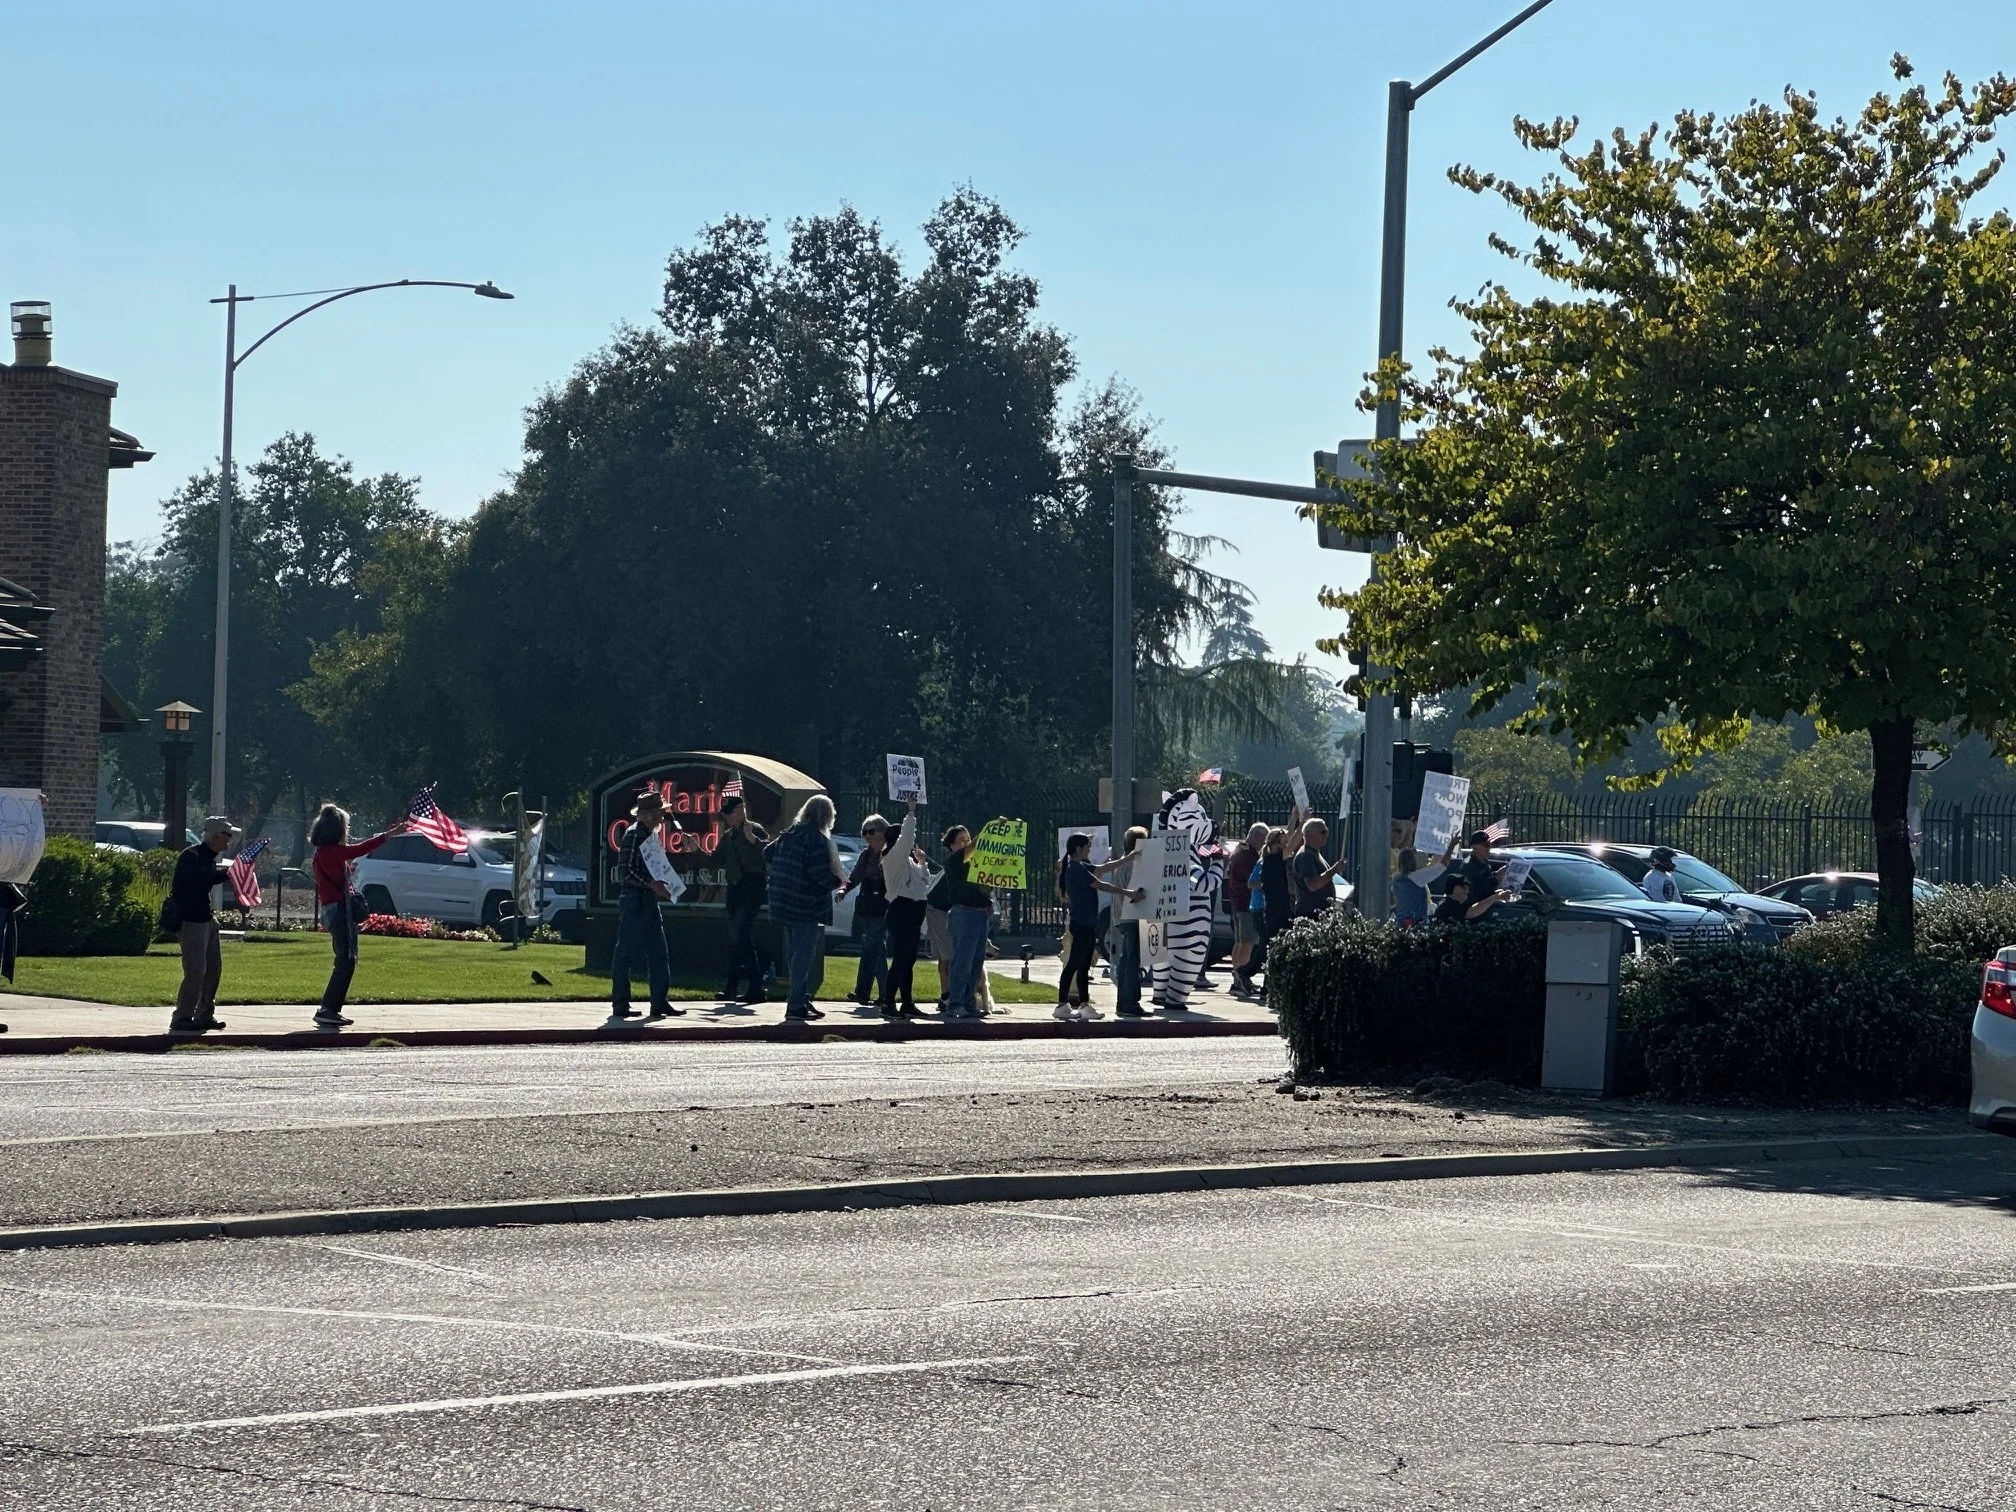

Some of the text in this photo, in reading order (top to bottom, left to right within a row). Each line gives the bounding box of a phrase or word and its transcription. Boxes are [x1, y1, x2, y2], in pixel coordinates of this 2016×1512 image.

[1911, 751, 1924, 762] AY
[892, 764, 919, 777] People
[984, 823, 1010, 837] KEEP
[976, 838, 1026, 857] IMMIGRANTS
[1165, 835, 1188, 852] SIST
[1163, 863, 1188, 878] ERICA
[976, 871, 1019, 888] RACISTS
